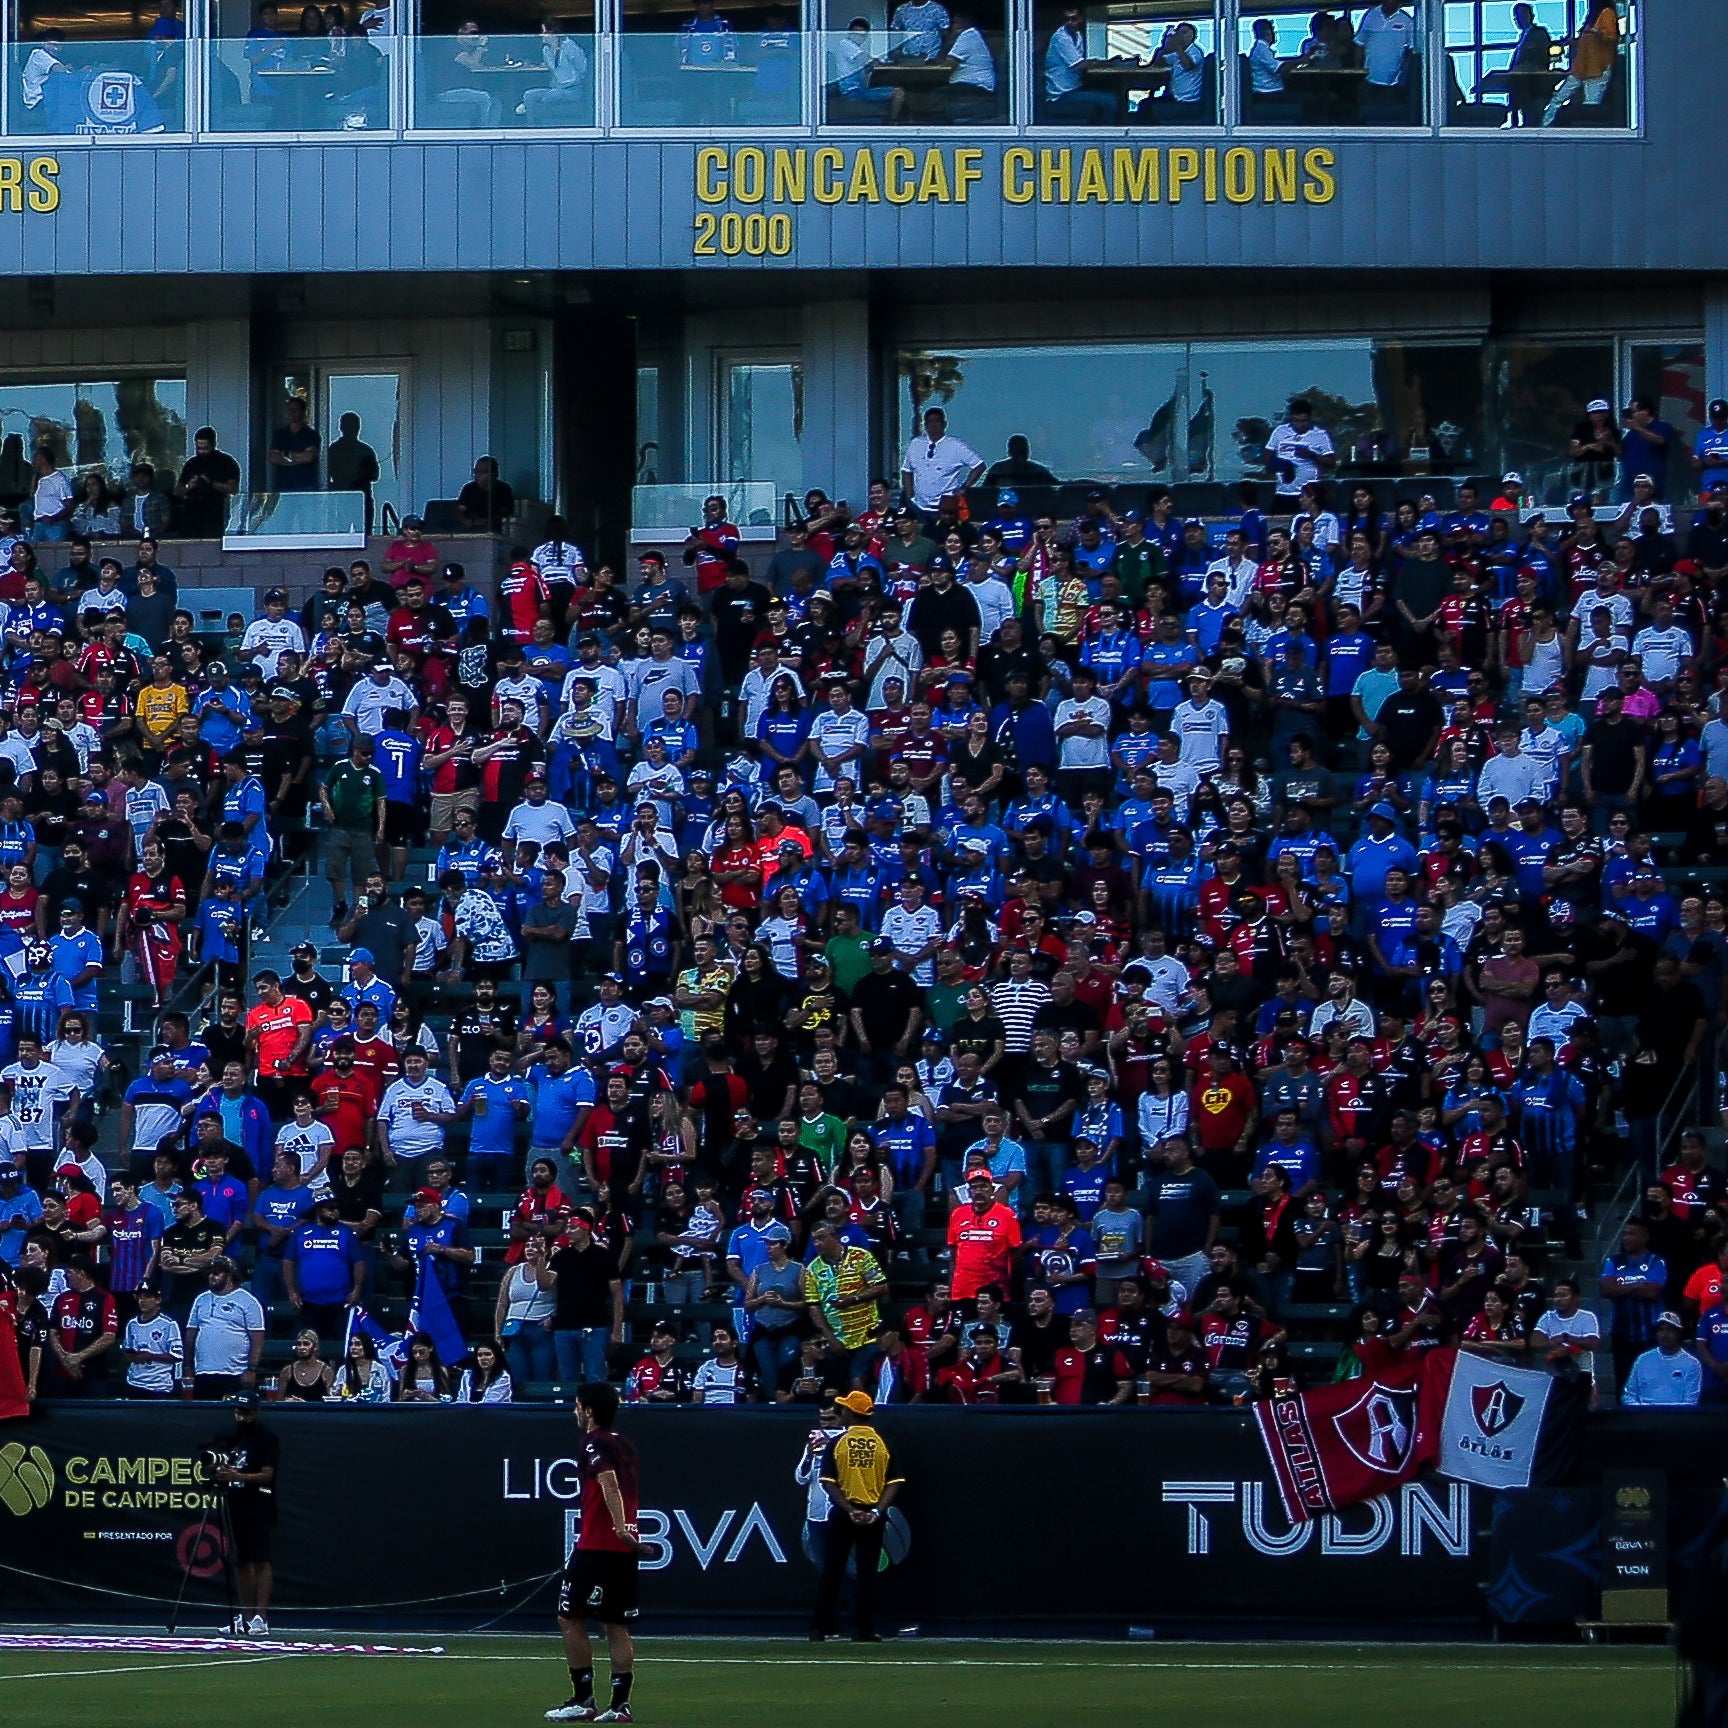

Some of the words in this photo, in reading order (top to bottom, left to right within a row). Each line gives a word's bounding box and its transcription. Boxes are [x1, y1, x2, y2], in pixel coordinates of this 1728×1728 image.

[696, 145, 984, 204] CONCACAF
[1001, 145, 1337, 204] CHAMPIONS
[693, 211, 791, 256] 2000
[390, 751, 404, 779] 7
[19, 1109, 45, 1124] 87
[846, 1438, 876, 1451] CSC
[502, 1458, 580, 1500] LIG
[65, 1490, 96, 1509] DE
[1161, 1480, 1470, 1556] TUDN
[98, 1531, 154, 1541] PRESENTADO
[156, 1531, 173, 1540] POR
[1615, 1565, 1650, 1575] TUDN
